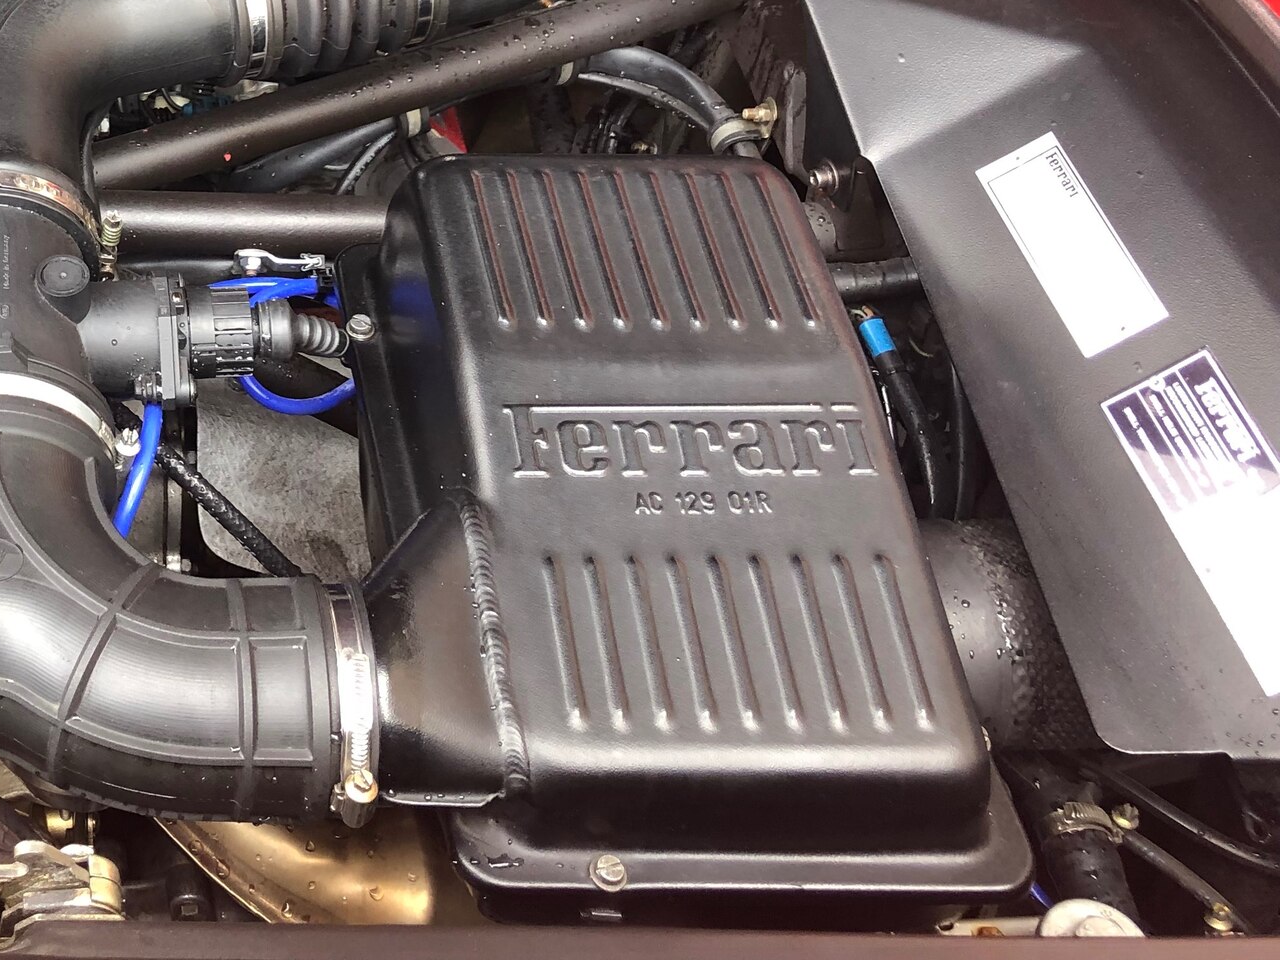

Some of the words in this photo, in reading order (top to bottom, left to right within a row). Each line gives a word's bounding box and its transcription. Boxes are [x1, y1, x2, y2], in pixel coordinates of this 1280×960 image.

[1045, 152, 1079, 198] Ferrari
[502, 403, 880, 478] Ferrari
[634, 490, 664, 515] AC
[674, 490, 716, 516] 129
